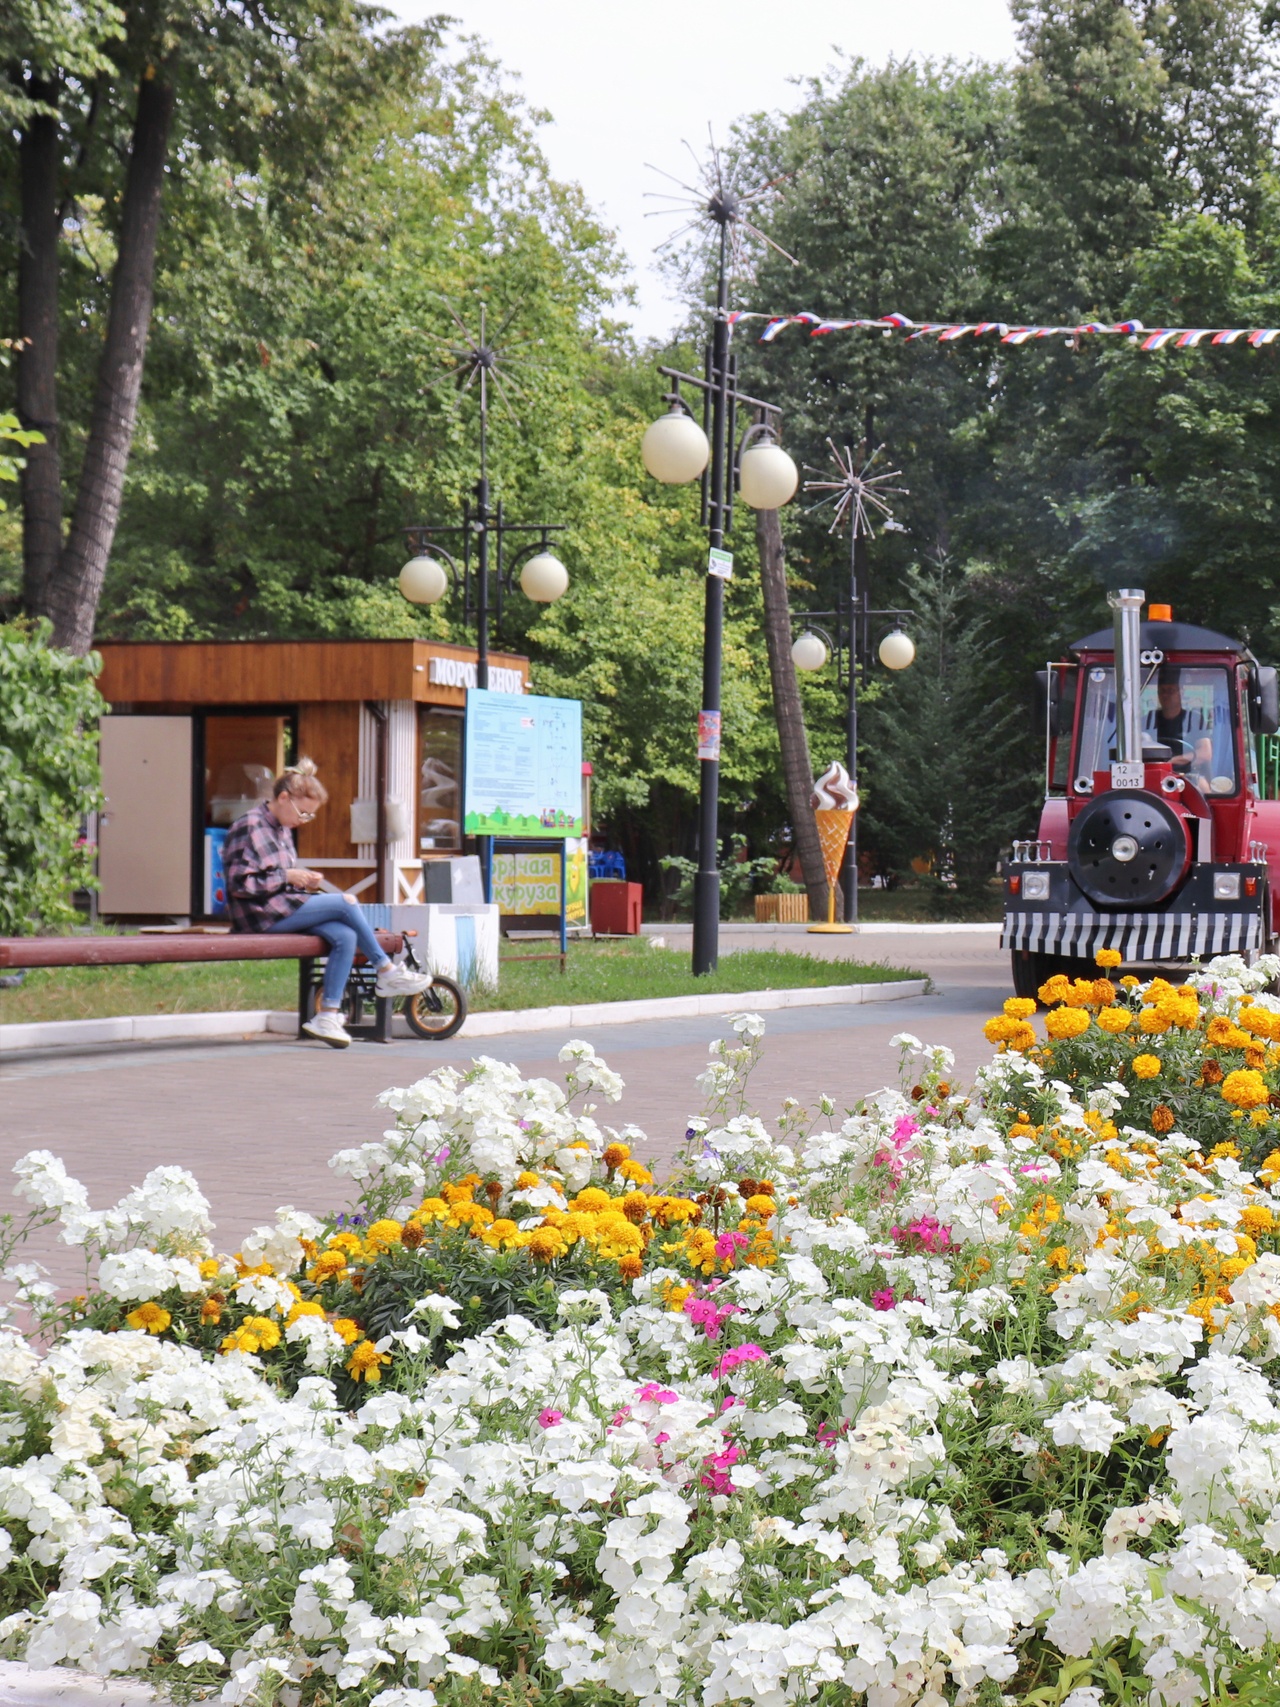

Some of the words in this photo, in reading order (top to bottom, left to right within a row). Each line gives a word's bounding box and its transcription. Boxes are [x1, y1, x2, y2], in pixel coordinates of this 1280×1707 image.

[432, 656, 523, 695] МОРОЕНОЕ
[1117, 766, 1127, 774] 12
[1116, 779, 1139, 787] 0013
[494, 885, 557, 907] куруза
